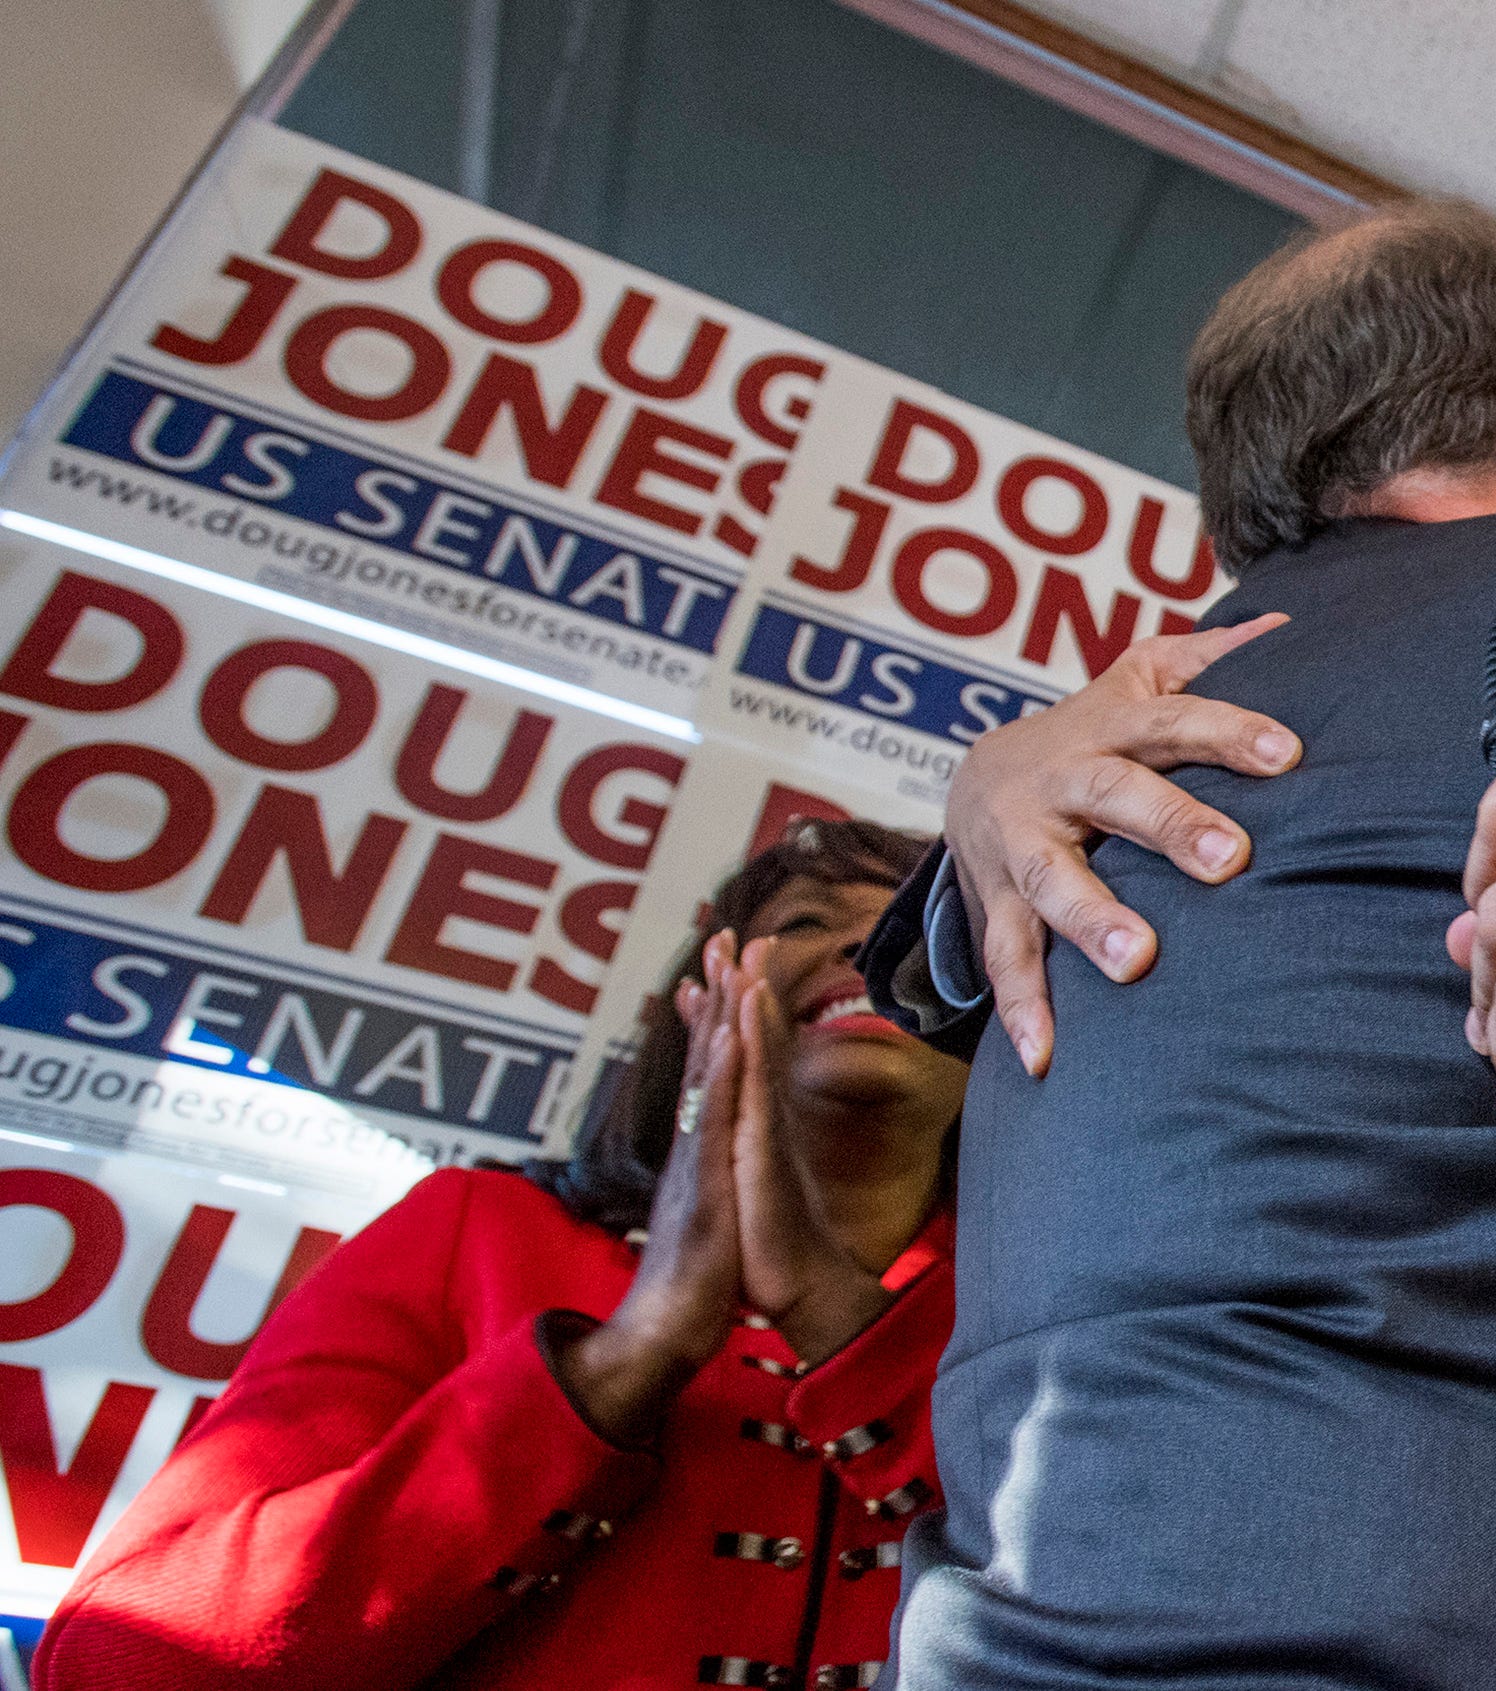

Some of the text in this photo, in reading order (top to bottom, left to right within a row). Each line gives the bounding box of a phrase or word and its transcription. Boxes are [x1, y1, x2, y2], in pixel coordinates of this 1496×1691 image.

[272, 170, 828, 450] DOUG
[130, 392, 312, 501] US
[47, 454, 712, 686] www.dougjonesforsenate.
[786, 622, 923, 716] US
[789, 488, 1196, 684] JON
[0, 570, 687, 871] DOUG
[0, 710, 638, 1014] ONES
[64, 954, 568, 1135] SENAT
